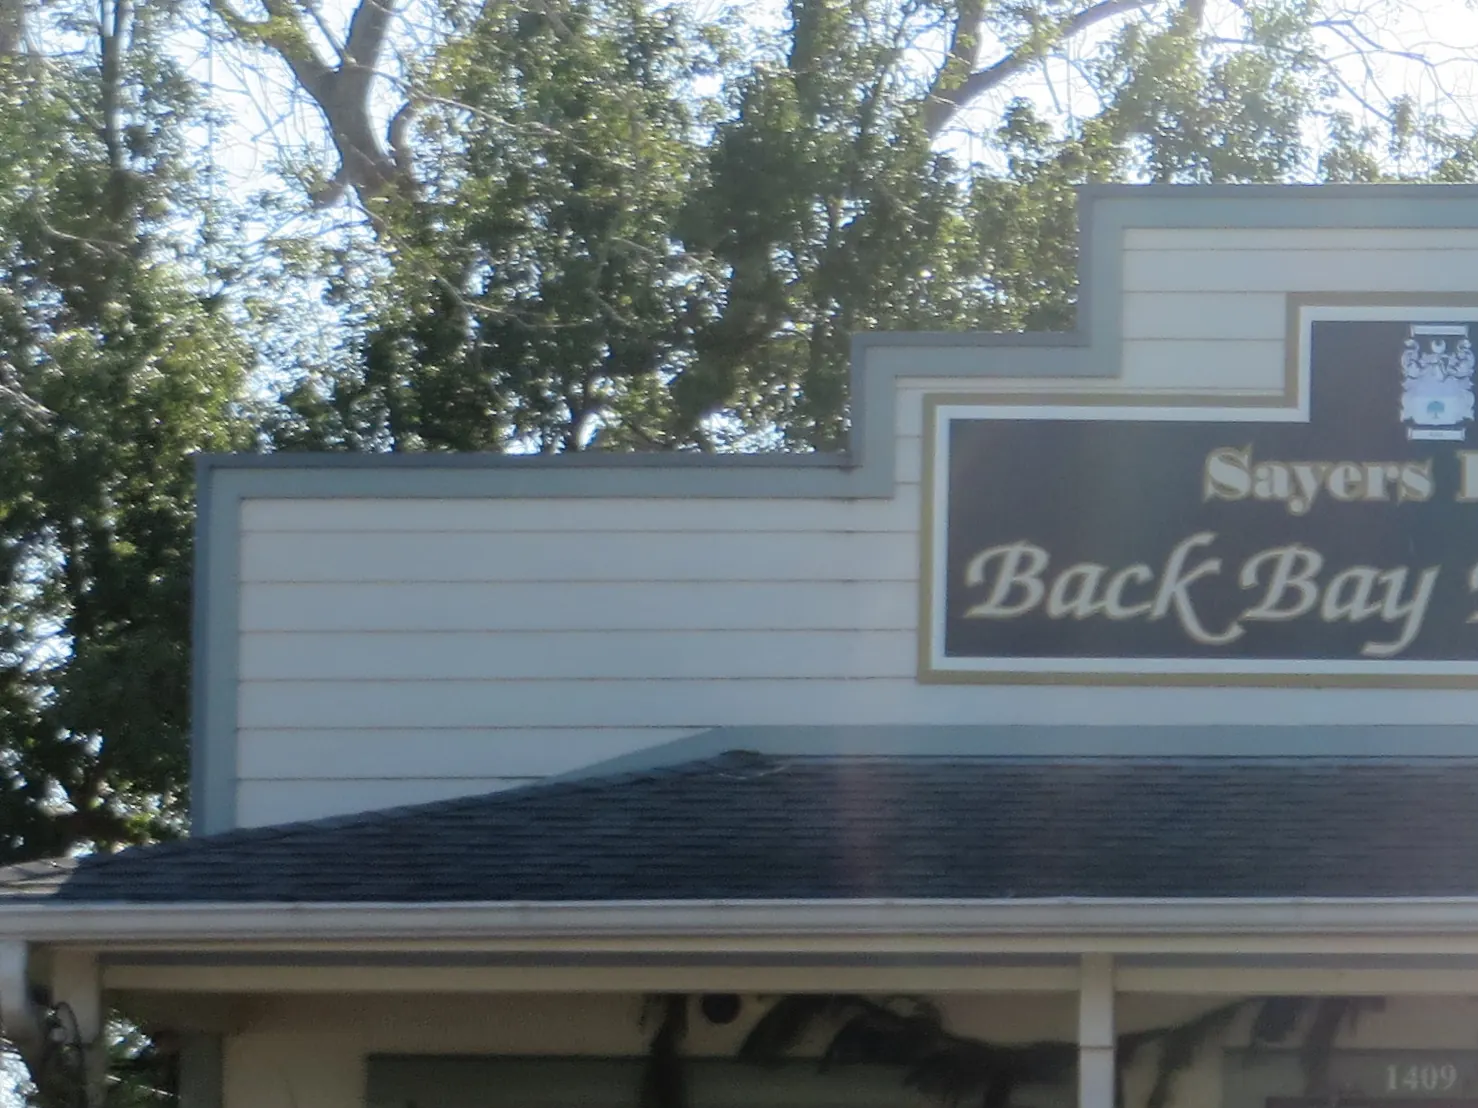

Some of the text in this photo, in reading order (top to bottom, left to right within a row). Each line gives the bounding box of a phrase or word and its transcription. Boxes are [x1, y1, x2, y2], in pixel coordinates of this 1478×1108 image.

[1204, 445, 1432, 515] Sayers
[963, 531, 1246, 646] Back
[1237, 545, 1440, 656] Bay
[1386, 1063, 1458, 1092] 1409
